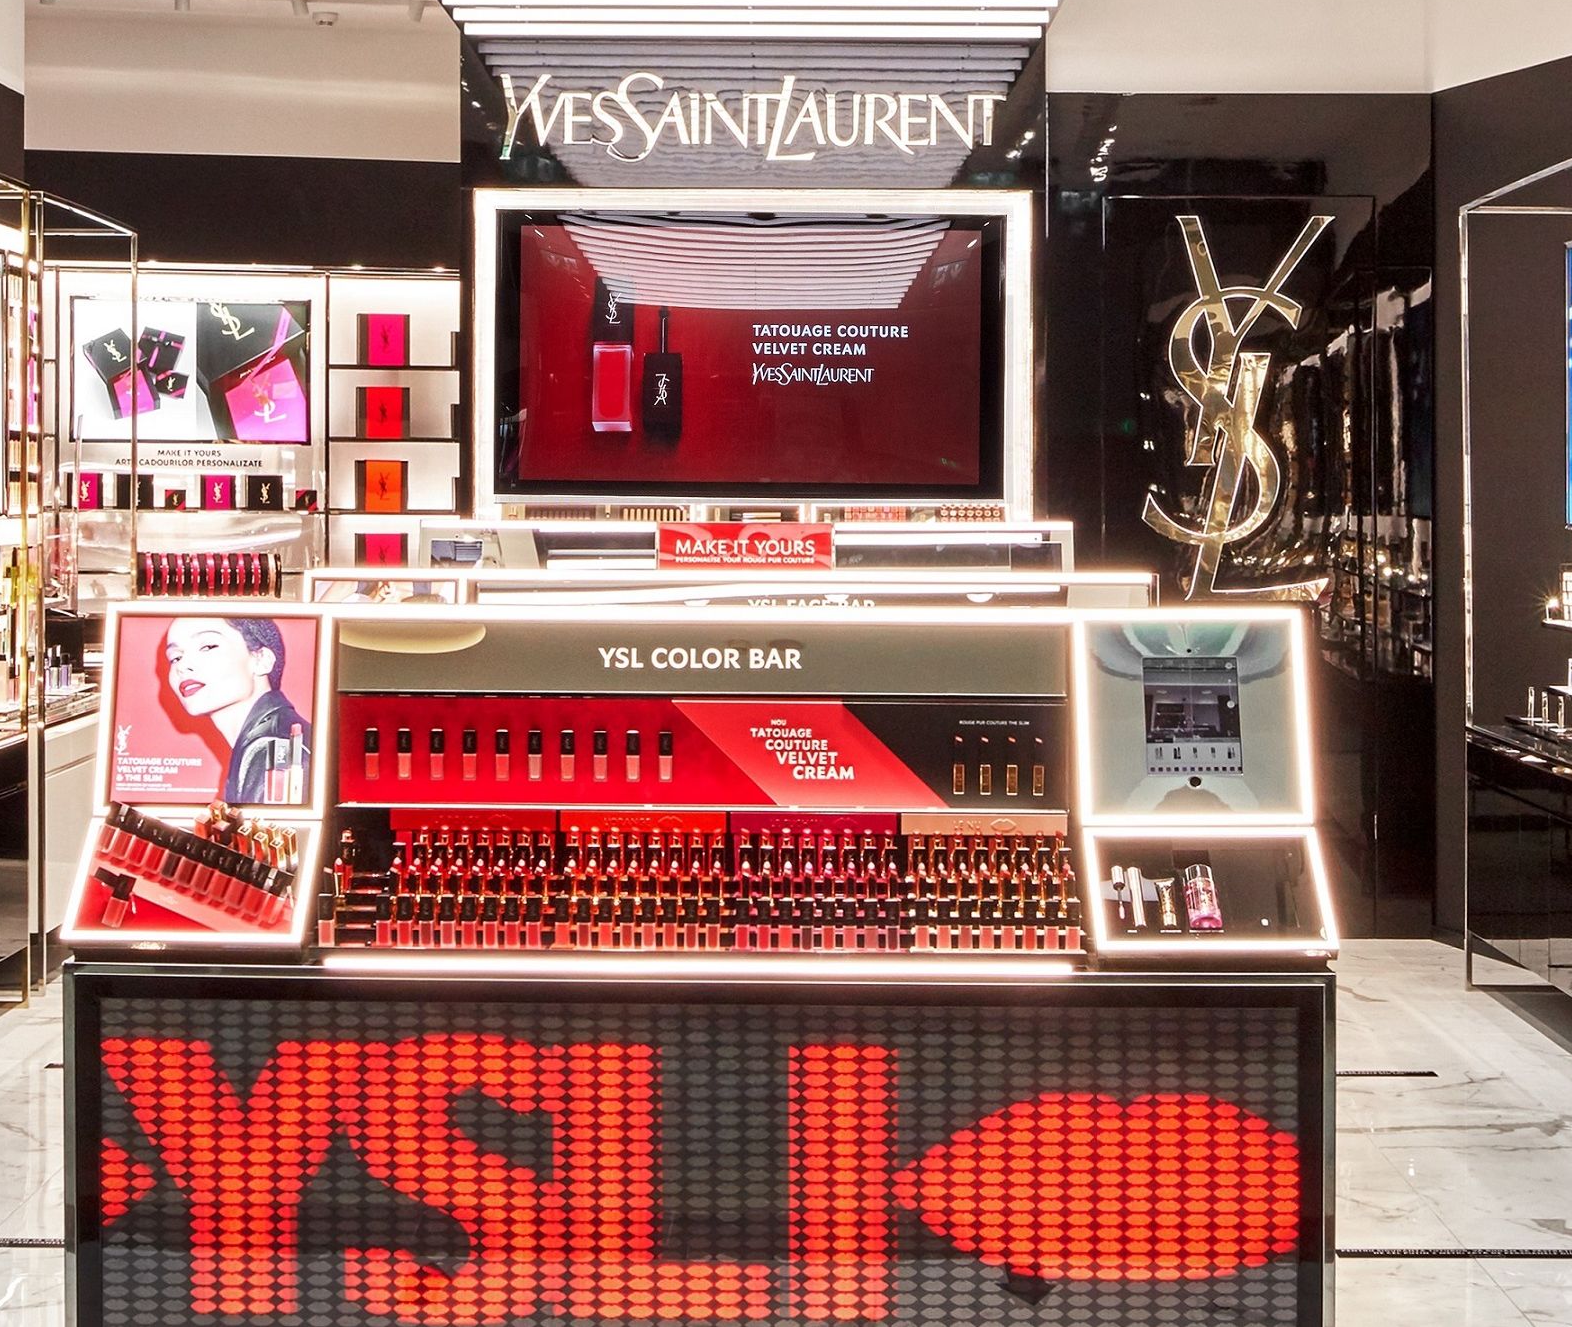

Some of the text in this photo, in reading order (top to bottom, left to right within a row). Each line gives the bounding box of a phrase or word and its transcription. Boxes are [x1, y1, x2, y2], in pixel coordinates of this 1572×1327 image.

[752, 324, 909, 339] TATOUAGE COUTURE
[752, 342, 867, 356] VELVET CREAM
[1141, 215, 1336, 602] YSL
[157, 449, 222, 458] MAKE IT YOURS
[115, 458, 263, 468] ART CADOURILOR PERSONALIZATE
[675, 539, 816, 555] MAKE IT YOURS
[767, 556, 782, 564] PUR
[782, 556, 815, 564] COUTURE
[598, 647, 802, 670] YSL COLOR BAR
[749, 727, 812, 739] TATOUAGE
[765, 739, 828, 751] COUTURE
[775, 751, 838, 765] VELVET
[792, 765, 855, 780] CREAM
